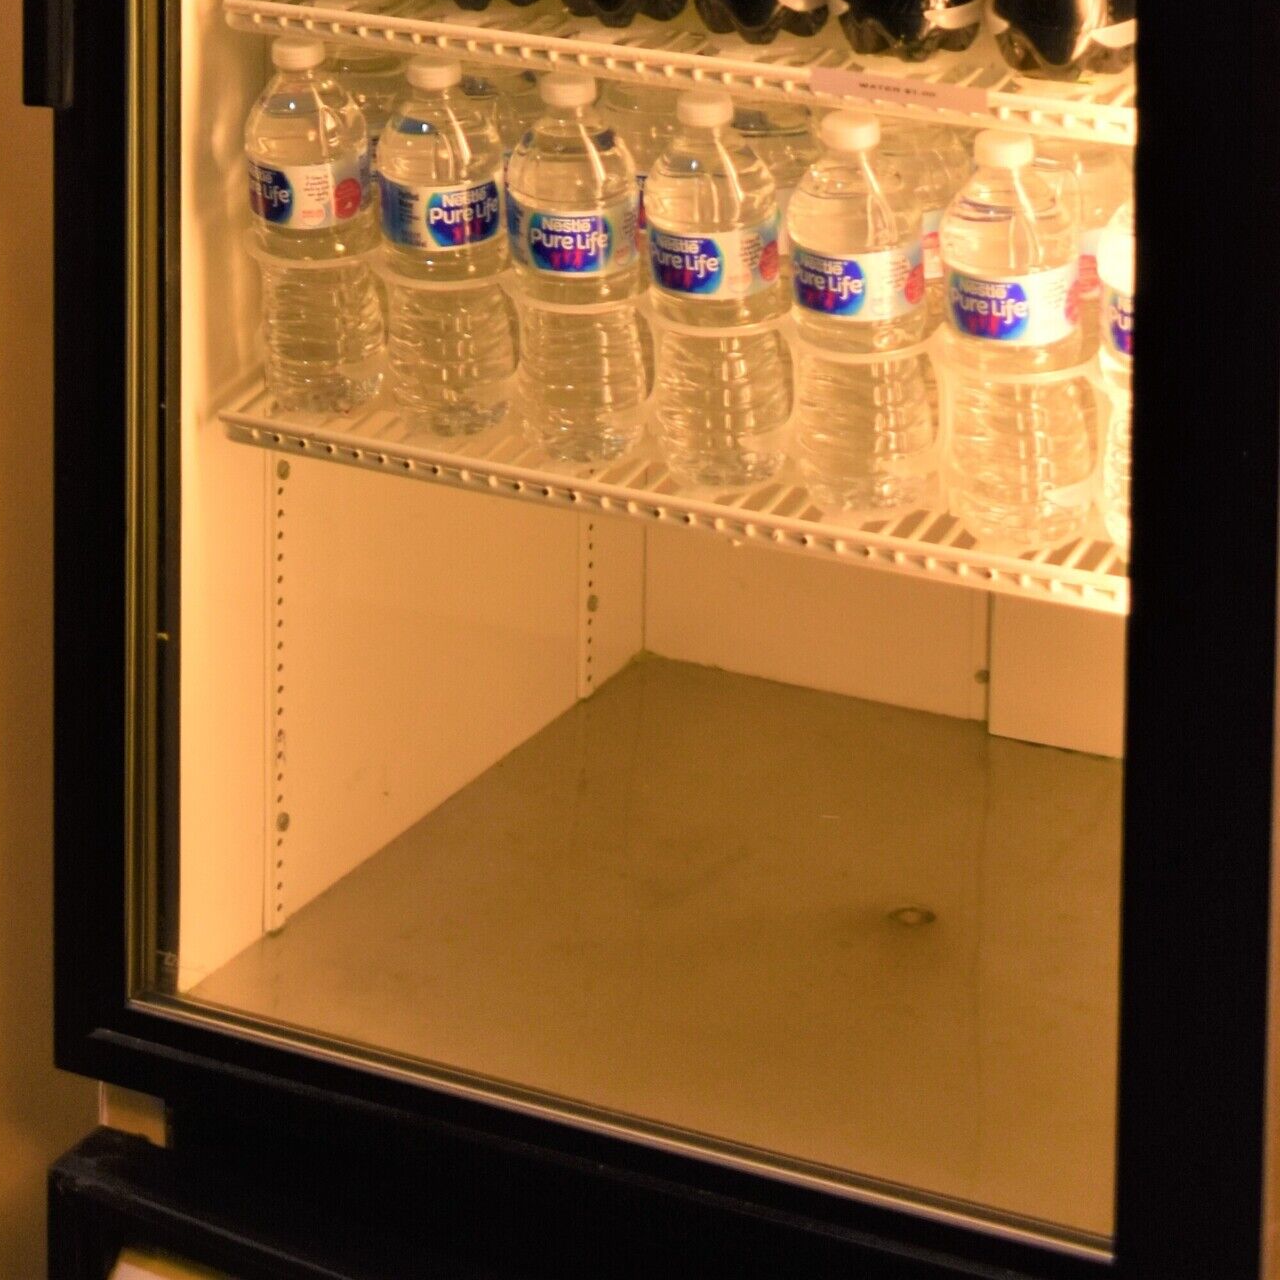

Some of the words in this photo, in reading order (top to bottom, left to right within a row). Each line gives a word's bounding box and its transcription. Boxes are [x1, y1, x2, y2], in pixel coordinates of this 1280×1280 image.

[430, 207, 474, 225] Pure
[530, 228, 574, 250] Pure
[576, 231, 608, 256] Life
[685, 254, 719, 278] Life
[828, 276, 863, 300] Life
[951, 288, 989, 316] Pure
[991, 298, 1028, 325] Life
